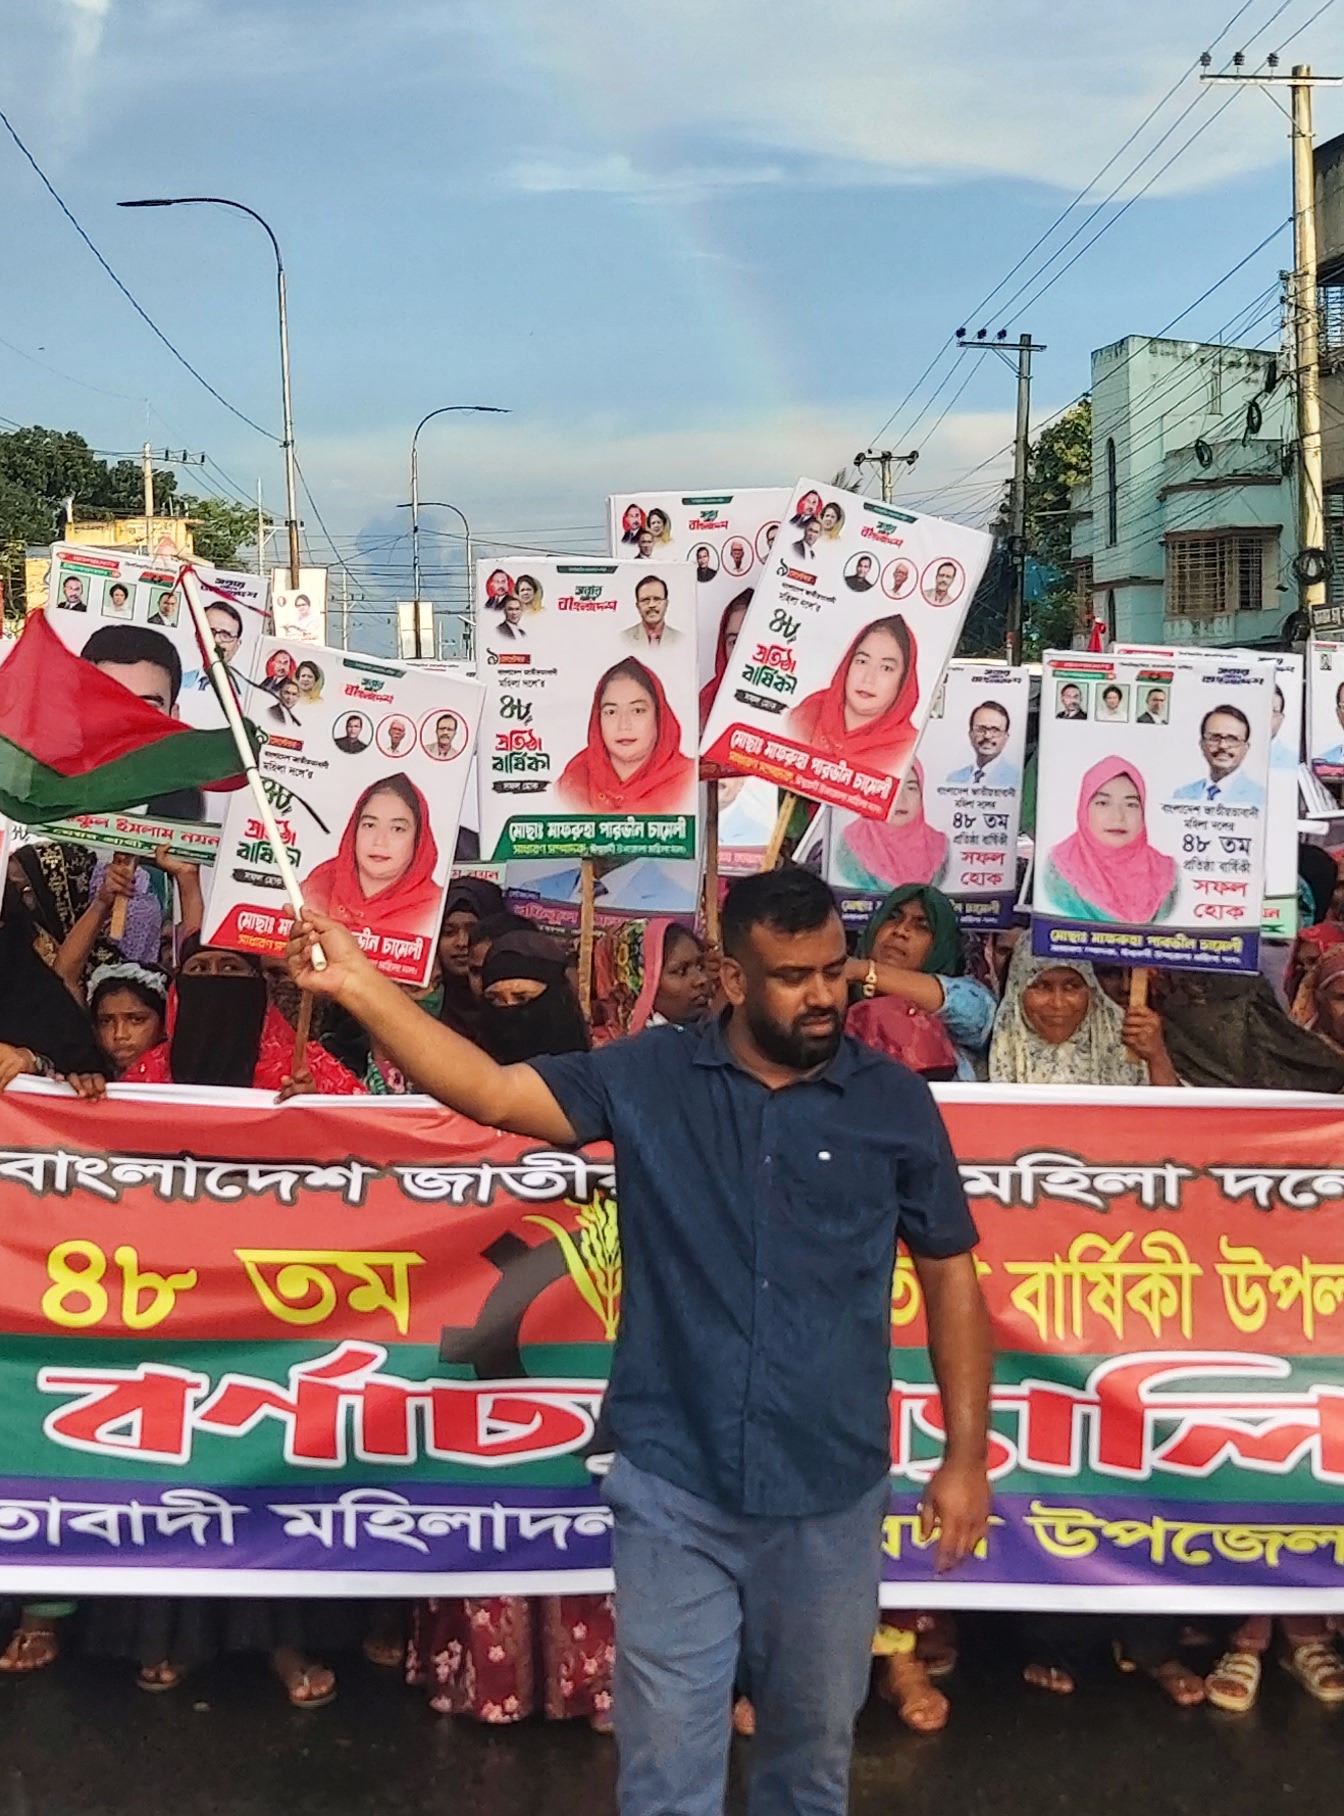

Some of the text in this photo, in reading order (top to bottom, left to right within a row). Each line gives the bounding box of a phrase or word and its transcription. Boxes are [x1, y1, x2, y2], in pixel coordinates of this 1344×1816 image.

[742, 664, 798, 694] বার্ষিকী
[496, 729, 542, 751] প্রতিষ্ঠা
[492, 751, 550, 773] বার্ষিকী
[509, 822, 544, 840] মোছাঃ
[599, 816, 645, 840] পারভীন
[647, 816, 687, 840] চামেলী
[953, 813, 1009, 830] ৪৮ তম
[116, 818, 174, 840] ইসলাম
[181, 831, 221, 848] নয়ন
[1182, 834, 1252, 855] ৪৮ তম
[960, 851, 1005, 866] সফল
[960, 871, 1003, 886] হোক
[1193, 878, 1248, 897] সফল
[1194, 902, 1246, 920] হোক
[238, 912, 275, 934] মোছাঃ
[382, 936, 423, 960] চামেলী
[961, 1152, 1197, 1210] মহিলা
[42, 1239, 197, 1329] ৪৮
[234, 1247, 426, 1336] তম
[1004, 1230, 1203, 1341] বার্ষিকী
